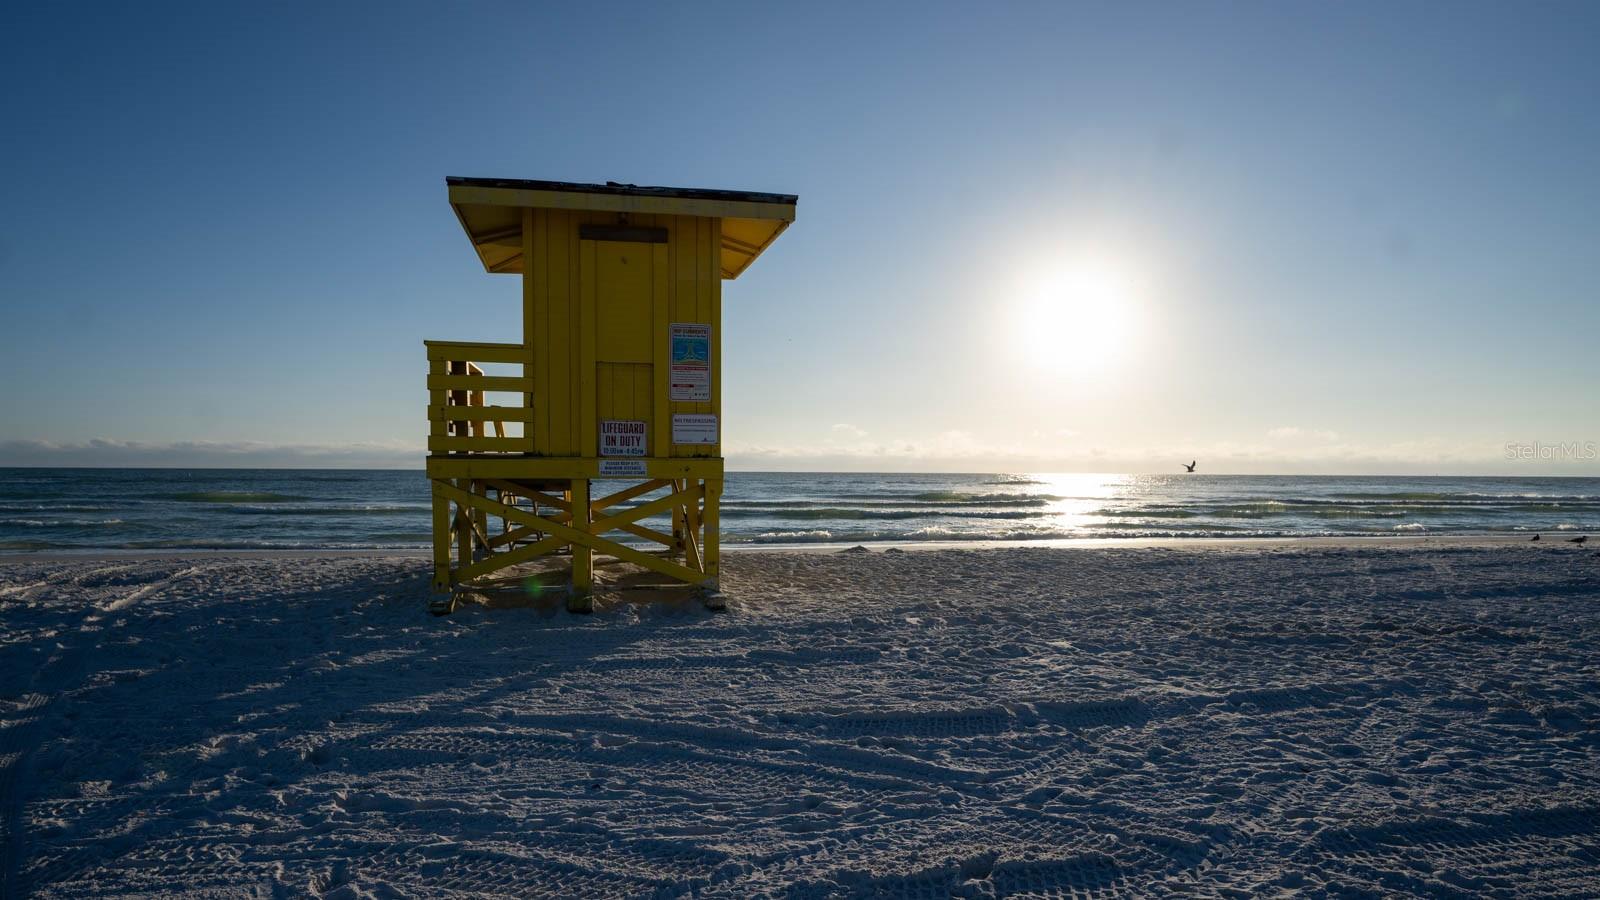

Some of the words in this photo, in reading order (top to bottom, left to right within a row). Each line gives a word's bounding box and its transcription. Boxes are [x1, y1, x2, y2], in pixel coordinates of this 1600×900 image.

[602, 423, 644, 434] LIFEGUARD
[605, 435, 617, 447] ON
[620, 435, 641, 447] DUTY
